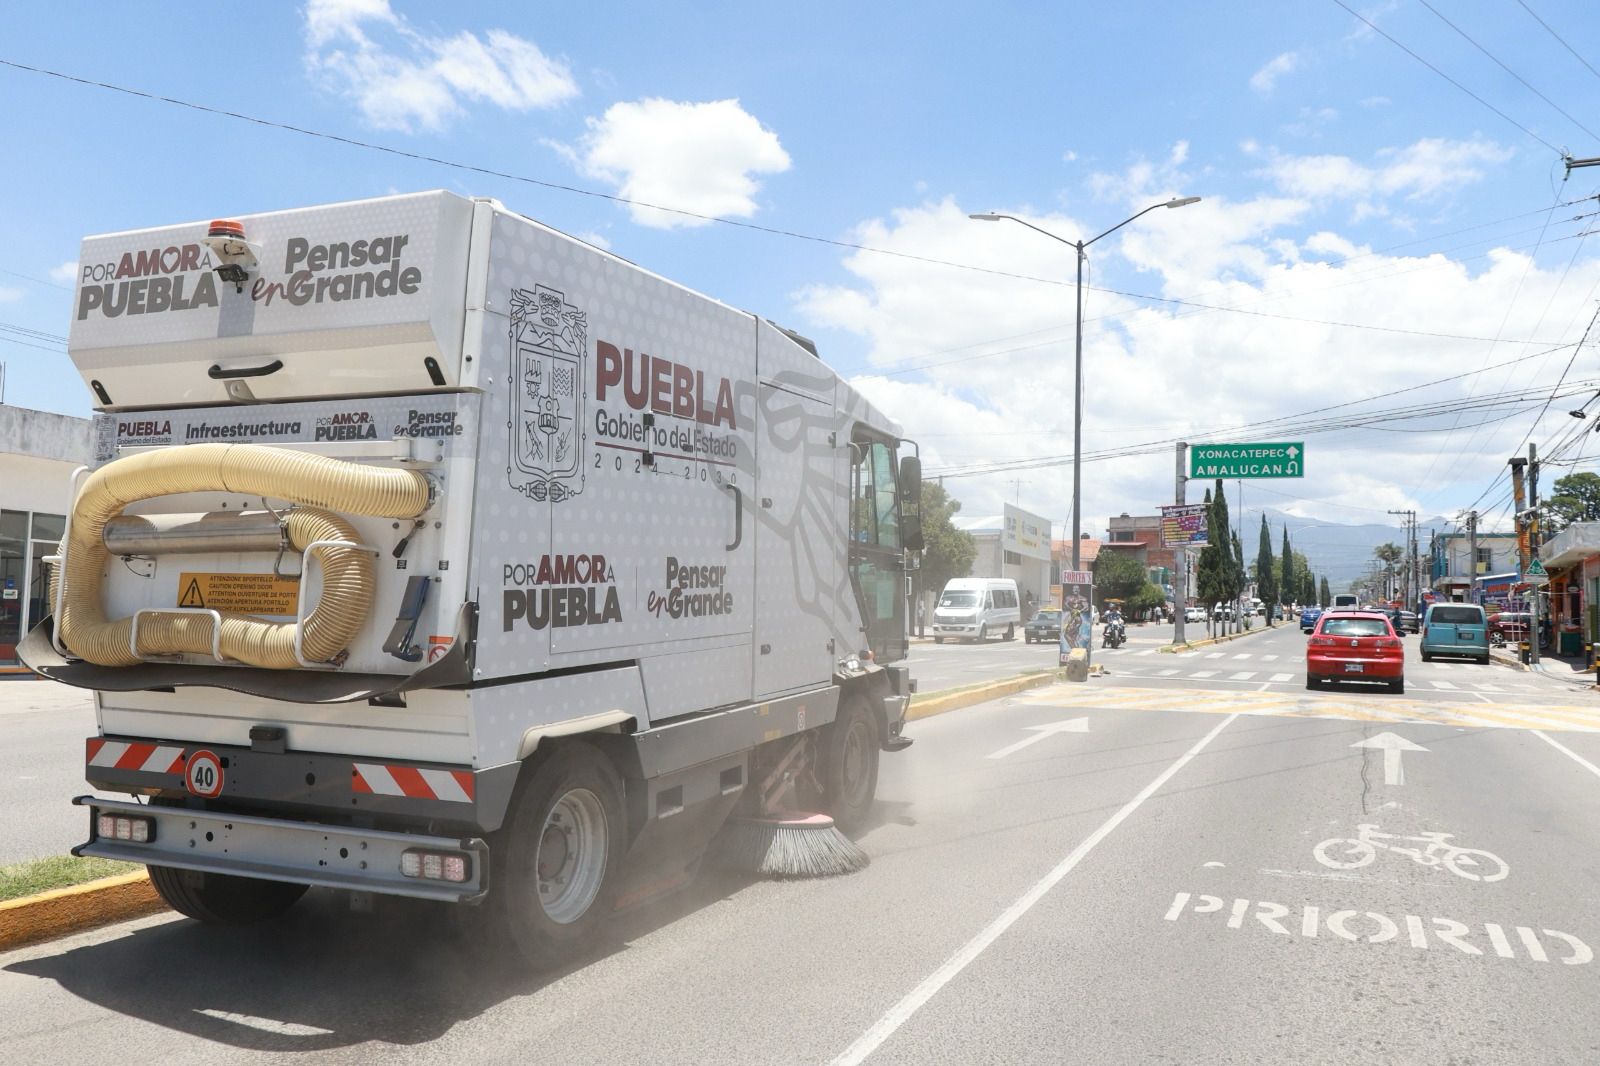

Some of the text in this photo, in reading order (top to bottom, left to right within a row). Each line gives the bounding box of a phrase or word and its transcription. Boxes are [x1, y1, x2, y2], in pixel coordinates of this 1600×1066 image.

[83, 263, 116, 283] POR
[115, 244, 201, 279] AMOR
[285, 234, 409, 274] Pensar
[78, 272, 219, 320] PUEBLA
[287, 259, 422, 306] Grande
[596, 339, 736, 431] PUEBLA
[118, 420, 172, 437] PUEBLA
[186, 421, 301, 439] Infraestructura
[315, 423, 378, 441] PUEBLA
[331, 411, 370, 425] AMOR
[408, 409, 458, 425] Pensar
[595, 408, 737, 458] Gobierno del Estado
[1196, 464, 1282, 475] AMALUCAN
[1198, 448, 1285, 459] XONACATEPEC
[503, 564, 536, 586] POR
[535, 554, 607, 585] AMOR
[666, 556, 727, 589] Pensar
[503, 586, 623, 632] PUEBLA
[668, 584, 733, 619] Grande
[195, 766, 214, 787] 40
[1163, 892, 1594, 966] PRIORID
